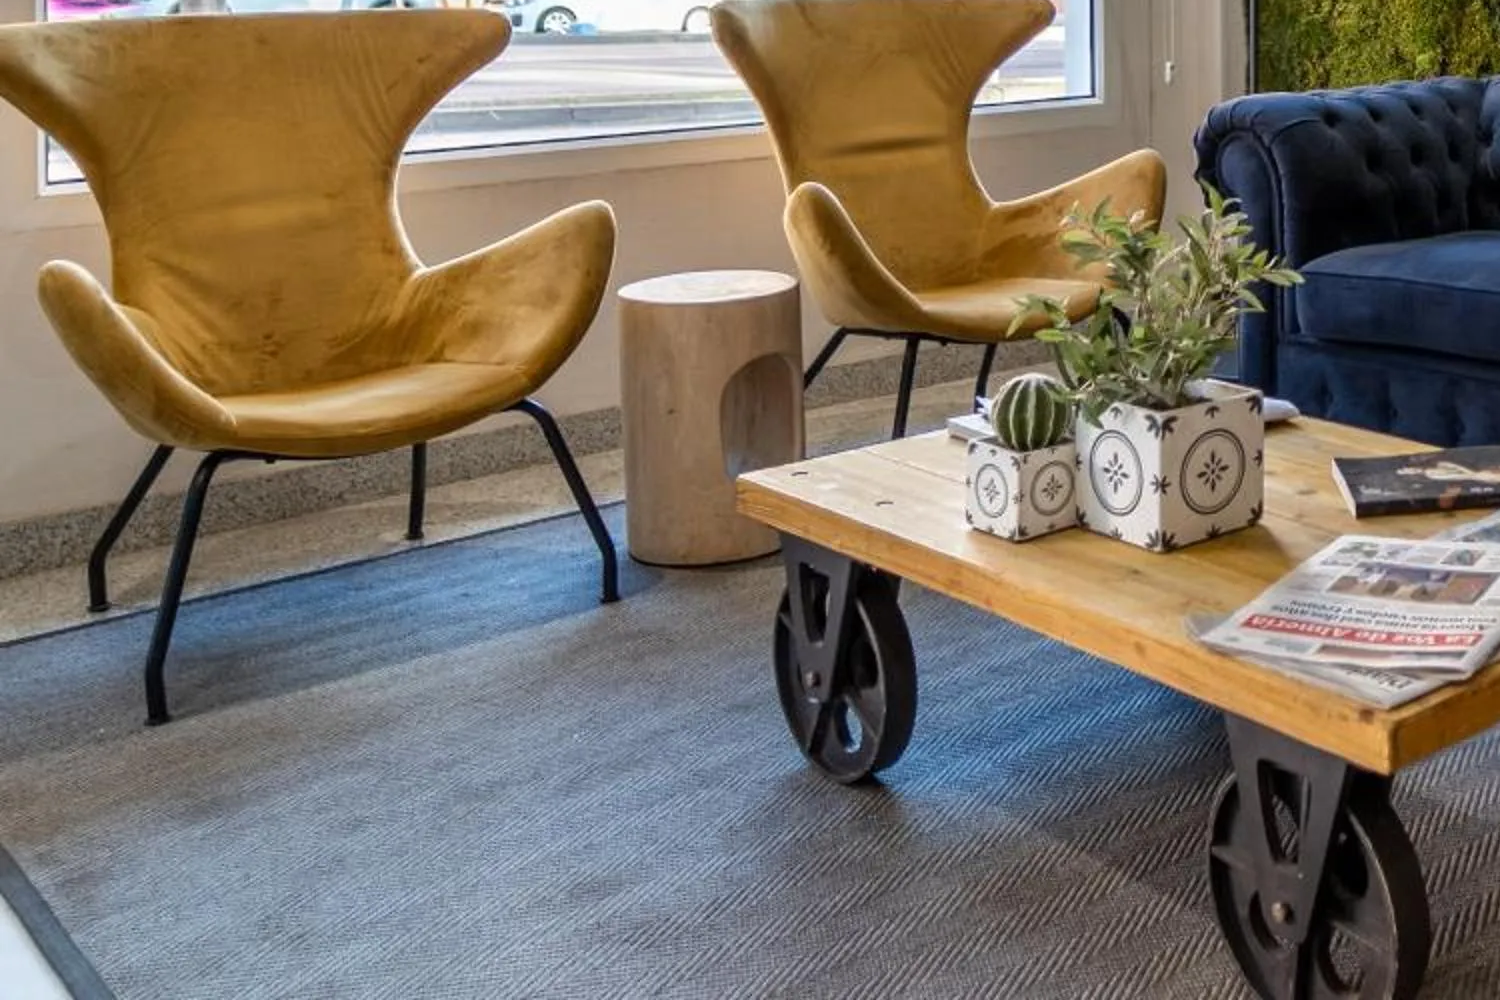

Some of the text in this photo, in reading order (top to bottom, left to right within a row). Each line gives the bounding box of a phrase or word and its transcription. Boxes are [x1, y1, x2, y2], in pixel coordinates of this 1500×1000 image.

[1354, 630, 1388, 643] de
[1391, 632, 1436, 646] Voz
[1444, 633, 1477, 646] La
